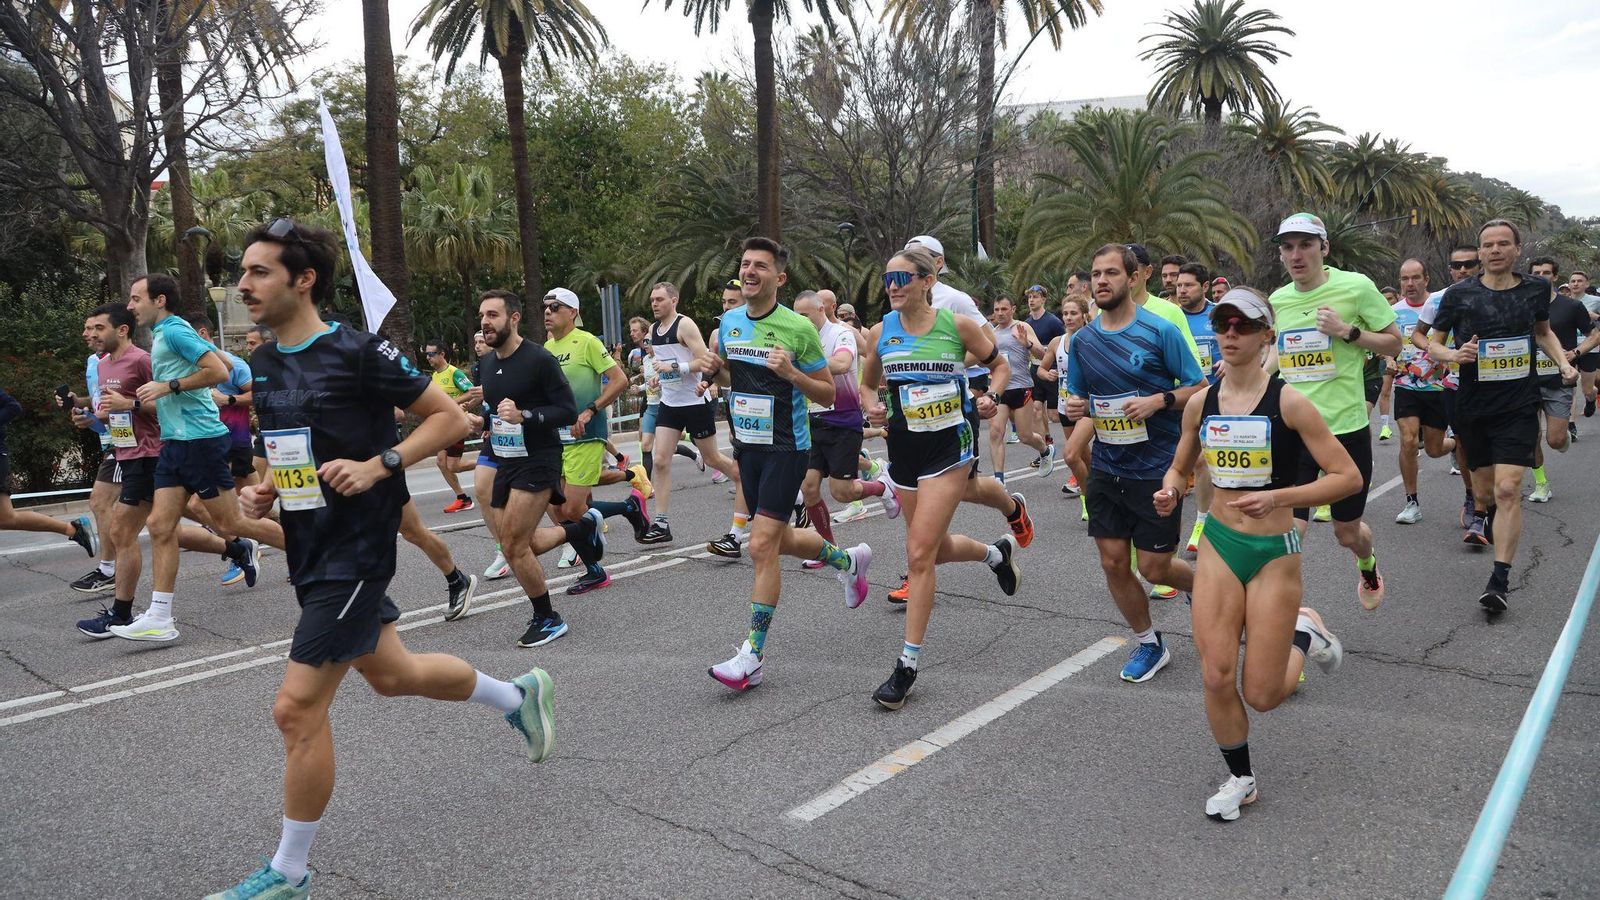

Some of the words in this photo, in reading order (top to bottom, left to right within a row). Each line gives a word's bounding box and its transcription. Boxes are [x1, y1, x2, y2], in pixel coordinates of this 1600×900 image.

[1290, 352, 1325, 368] 1024
[1491, 357, 1524, 370] 1918
[883, 362, 955, 374] TORREMOLINOS
[917, 401, 952, 420] 3118
[738, 416, 760, 431] 264
[1102, 418, 1134, 432] 1211
[497, 436, 515, 447] 624
[1216, 450, 1251, 469] 896
